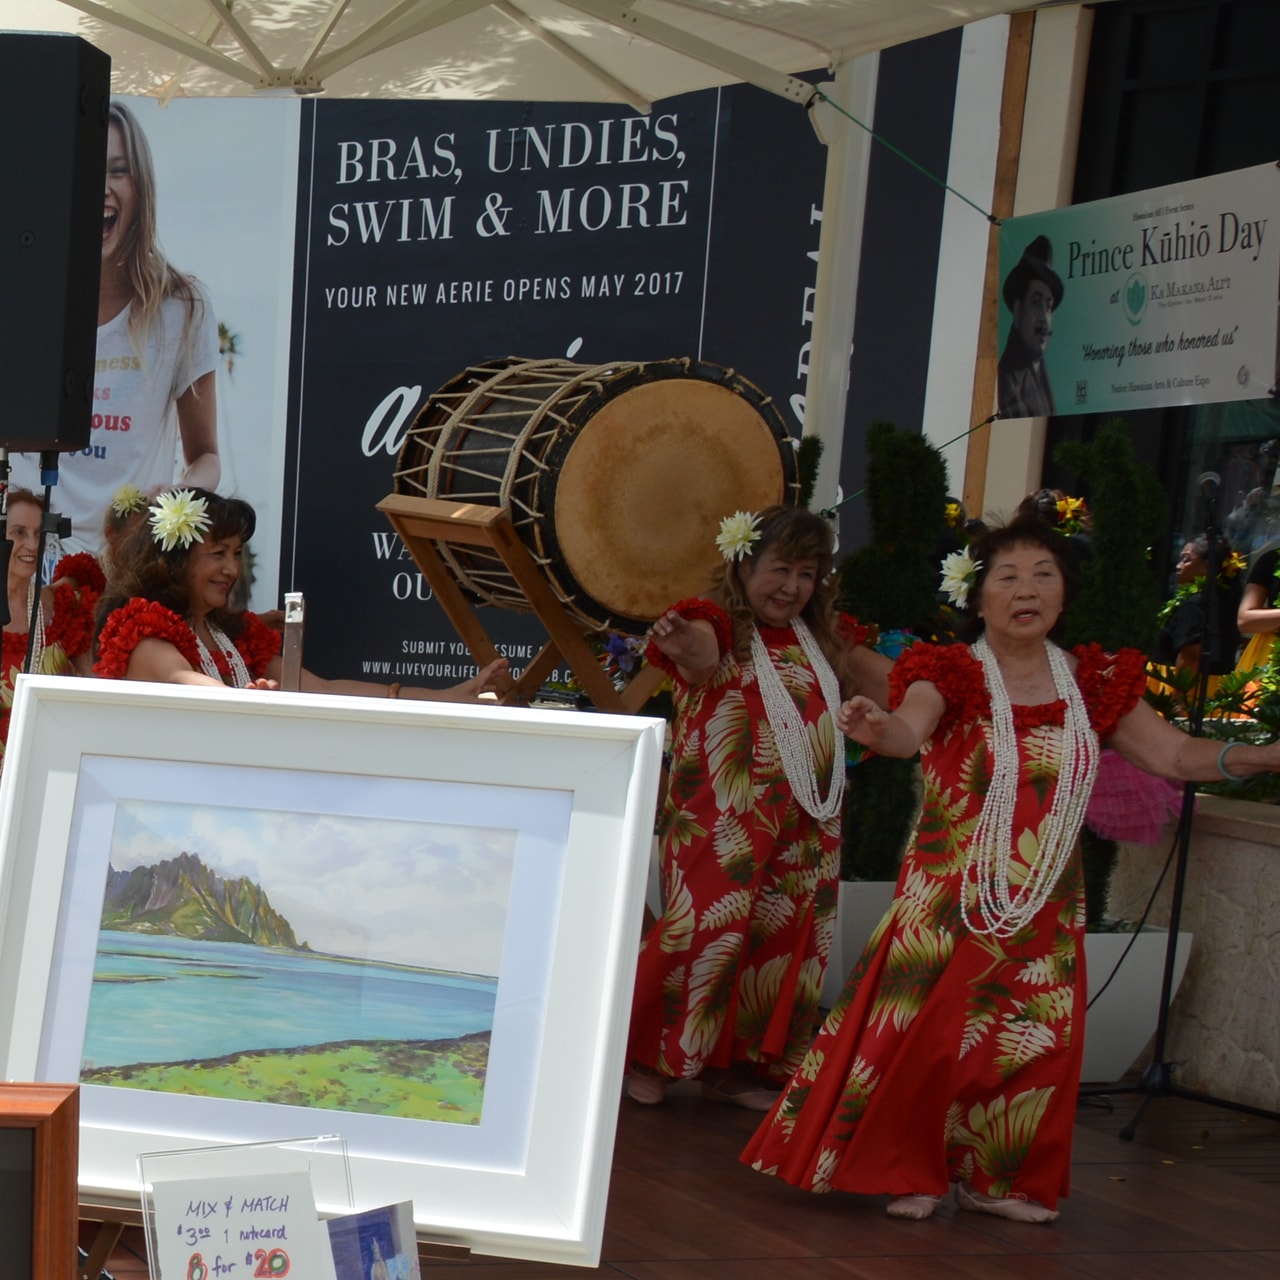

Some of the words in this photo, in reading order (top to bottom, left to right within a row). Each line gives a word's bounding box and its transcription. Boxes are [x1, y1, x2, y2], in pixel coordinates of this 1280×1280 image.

[335, 132, 463, 185] BRAS,
[485, 113, 686, 174] UNDIES,
[327, 196, 456, 246] SWIM
[475, 192, 513, 237] &
[534, 180, 689, 234] MORE
[1067, 240, 1133, 279] Prince
[1140, 221, 1210, 267] Kūhiō
[1217, 212, 1269, 261] Day
[325, 285, 378, 309] YOUR
[386, 283, 428, 306] NEW
[436, 280, 494, 304] AERIE
[503, 276, 572, 302] OPENS
[581, 273, 626, 299] MAY
[633, 271, 685, 296] 2017
[1128, 338, 1152, 356] those
[1177, 328, 1221, 351] honored
[401, 640, 447, 655] SUBMIT
[494, 644, 533, 659] ESUME
[185, 1200, 218, 1218] MIX
[240, 1195, 289, 1213] MATCH
[239, 1224, 288, 1241] notecard
[211, 1255, 236, 1277] for
